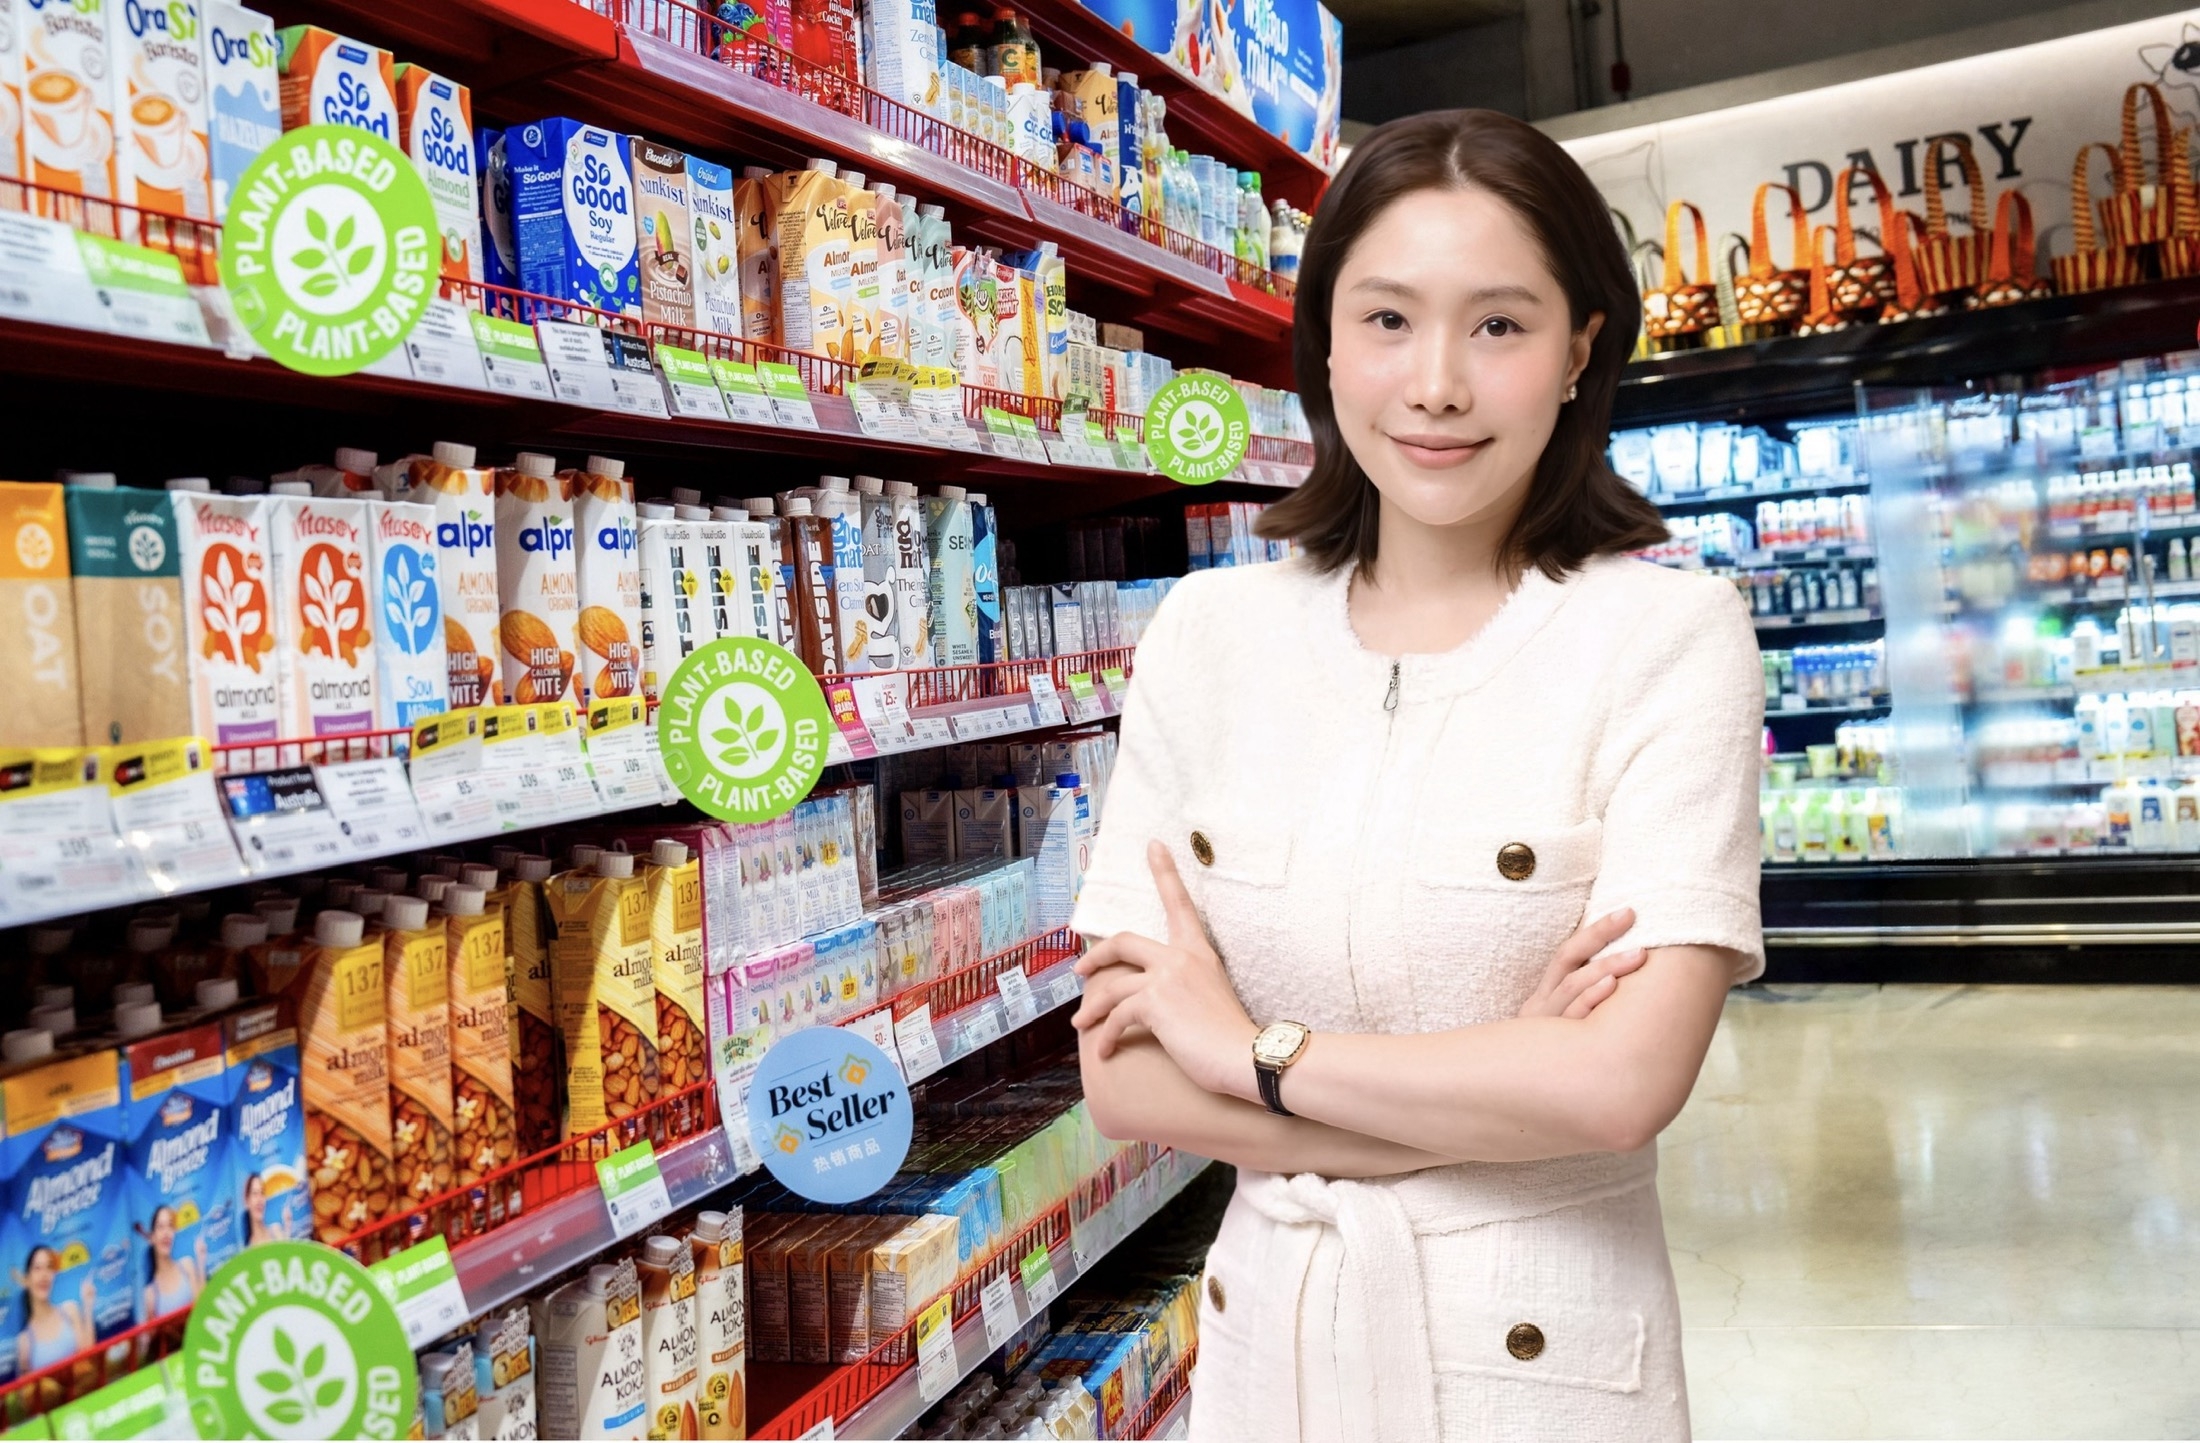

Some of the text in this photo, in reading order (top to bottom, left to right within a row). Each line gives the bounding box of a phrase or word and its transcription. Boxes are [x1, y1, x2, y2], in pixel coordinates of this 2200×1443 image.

[337, 71, 371, 112] So
[430, 106, 455, 143] So
[422, 129, 471, 176] Good
[1781, 116, 2033, 217] DAIRY
[523, 168, 561, 184] So Good
[584, 154, 612, 186] So
[573, 175, 628, 216] Good
[639, 173, 687, 207] Sunkist
[235, 138, 397, 277] PLANT-BASED
[589, 210, 613, 234] Soy
[692, 191, 734, 224] Sunkist
[272, 225, 429, 361] PLANT-BASED
[650, 280, 692, 307] Pistachio
[705, 291, 735, 317] Pistachio
[660, 304, 687, 326] Milk
[623, 353, 651, 371] Australia
[1151, 380, 1231, 440] PLANT-BASED
[1168, 420, 1244, 478] PLANT-BASED
[23, 584, 67, 691] OAT
[138, 585, 181, 685] SOY
[609, 642, 631, 658] HIGH
[447, 652, 479, 671] HIGH
[531, 647, 561, 667] HIGH
[215, 684, 277, 709] almond
[311, 674, 372, 701] almond
[406, 675, 434, 701] Soy
[449, 685, 469, 705] VIT
[533, 679, 551, 697] VIT
[669, 648, 797, 745] PLANT-BASED
[519, 773, 539, 789] 109
[623, 757, 641, 774] 109
[696, 718, 819, 813] PLANT-BASED
[275, 789, 322, 810] Australia
[624, 889, 648, 917] 137
[677, 880, 699, 905] 137
[414, 944, 444, 977] 137
[472, 929, 501, 960] 137
[344, 961, 381, 997] 137
[767, 1069, 836, 1119] Best
[805, 1089, 896, 1141] Seller
[811, 1137, 882, 1175] 热销商品
[196, 1256, 373, 1389] PLANT-BASED
